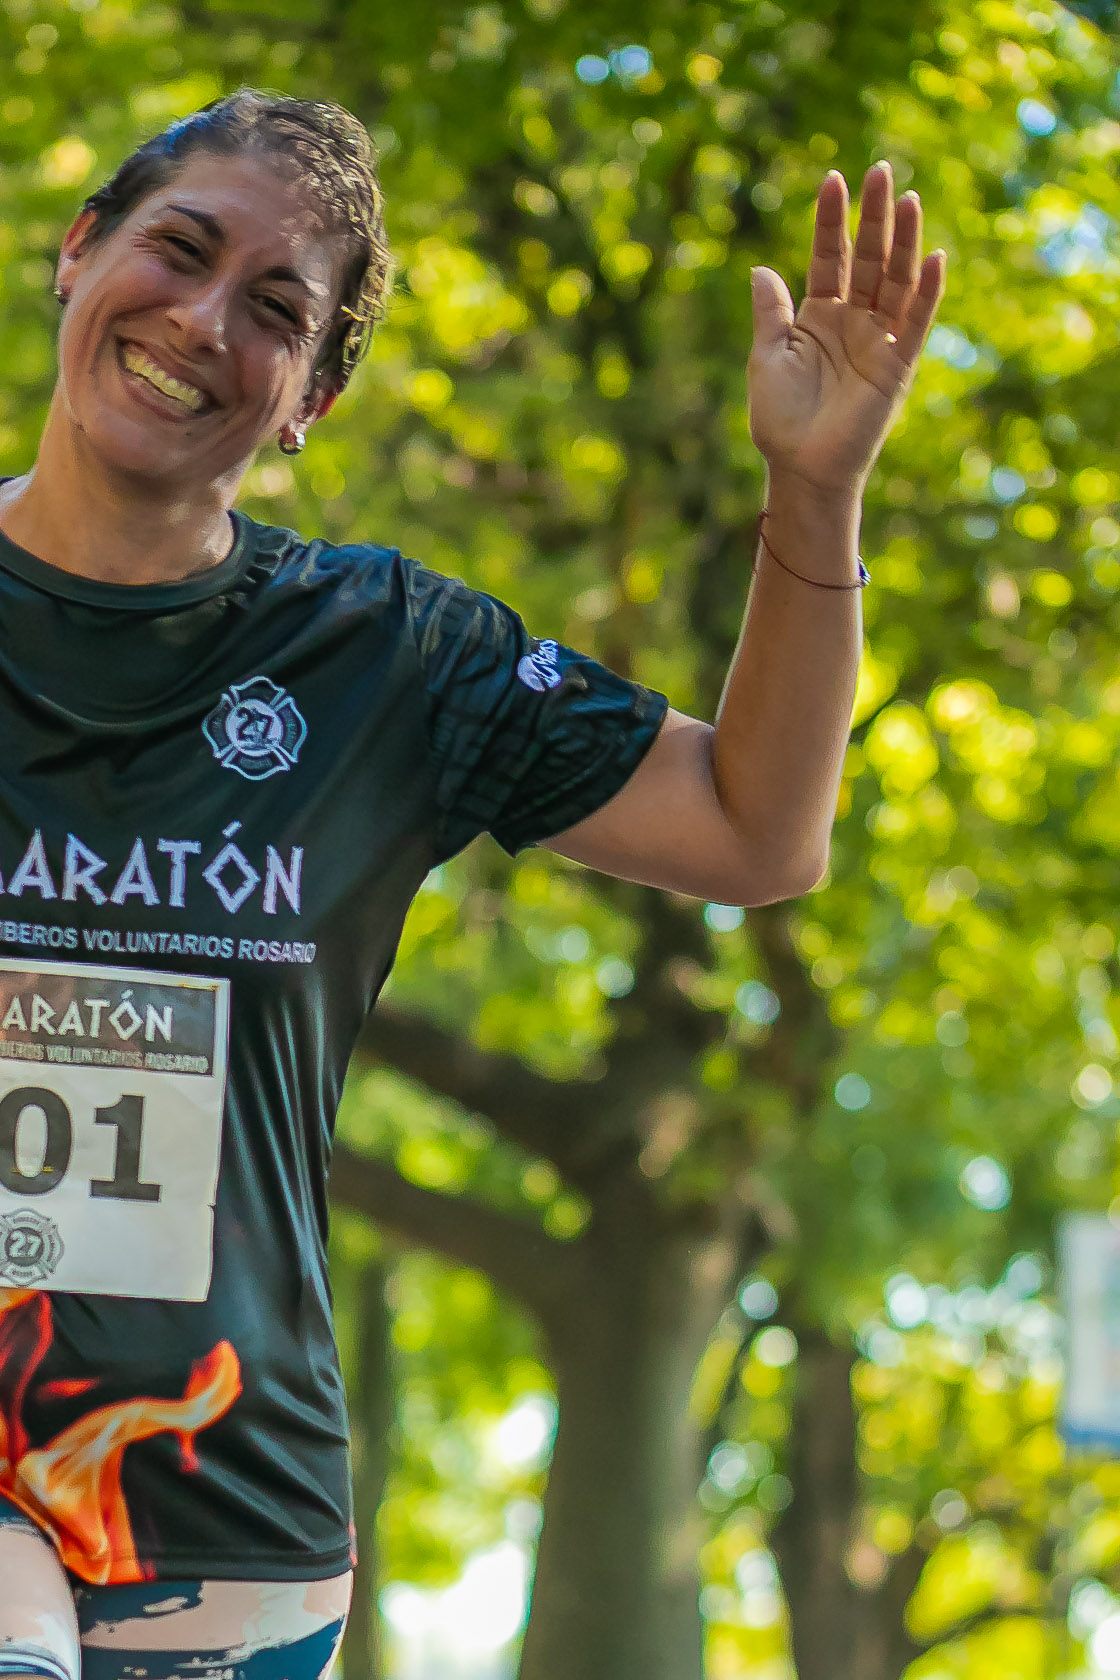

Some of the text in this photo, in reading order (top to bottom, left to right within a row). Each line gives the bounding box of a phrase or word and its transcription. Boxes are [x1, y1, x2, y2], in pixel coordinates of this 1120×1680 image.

[236, 706, 275, 741] 27
[82, 928, 235, 959] VOLUNTARIOS
[8, 1229, 42, 1258] 27
